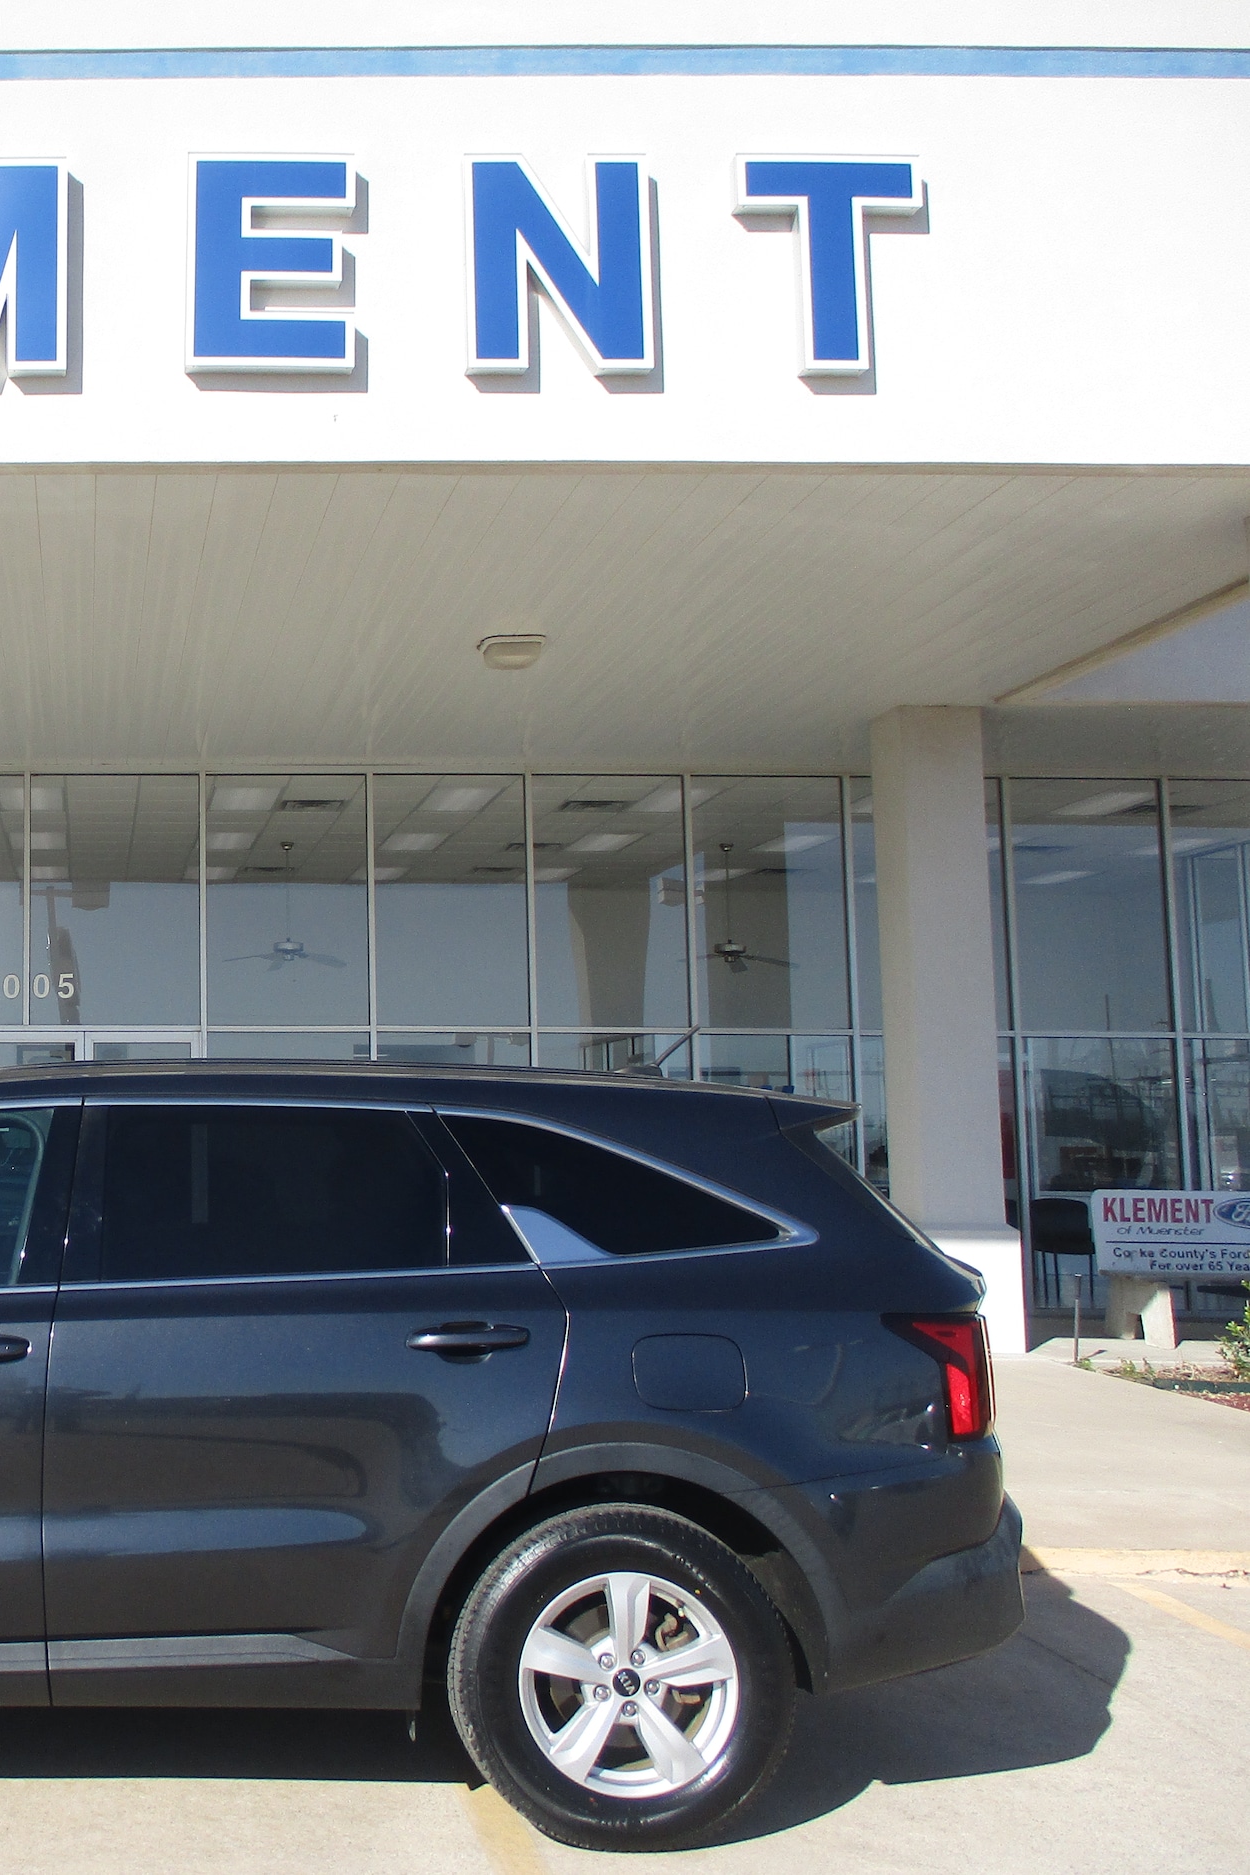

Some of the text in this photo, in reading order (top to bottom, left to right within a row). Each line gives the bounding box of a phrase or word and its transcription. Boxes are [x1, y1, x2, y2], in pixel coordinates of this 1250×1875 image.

[1102, 1197, 1214, 1223] KLEMENT
[1116, 1226, 1206, 1236] of Muenster
[1159, 1248, 1217, 1261] County's
[1150, 1260, 1250, 1272] For over 65 Yea
[617, 1671, 636, 1695] KIA
